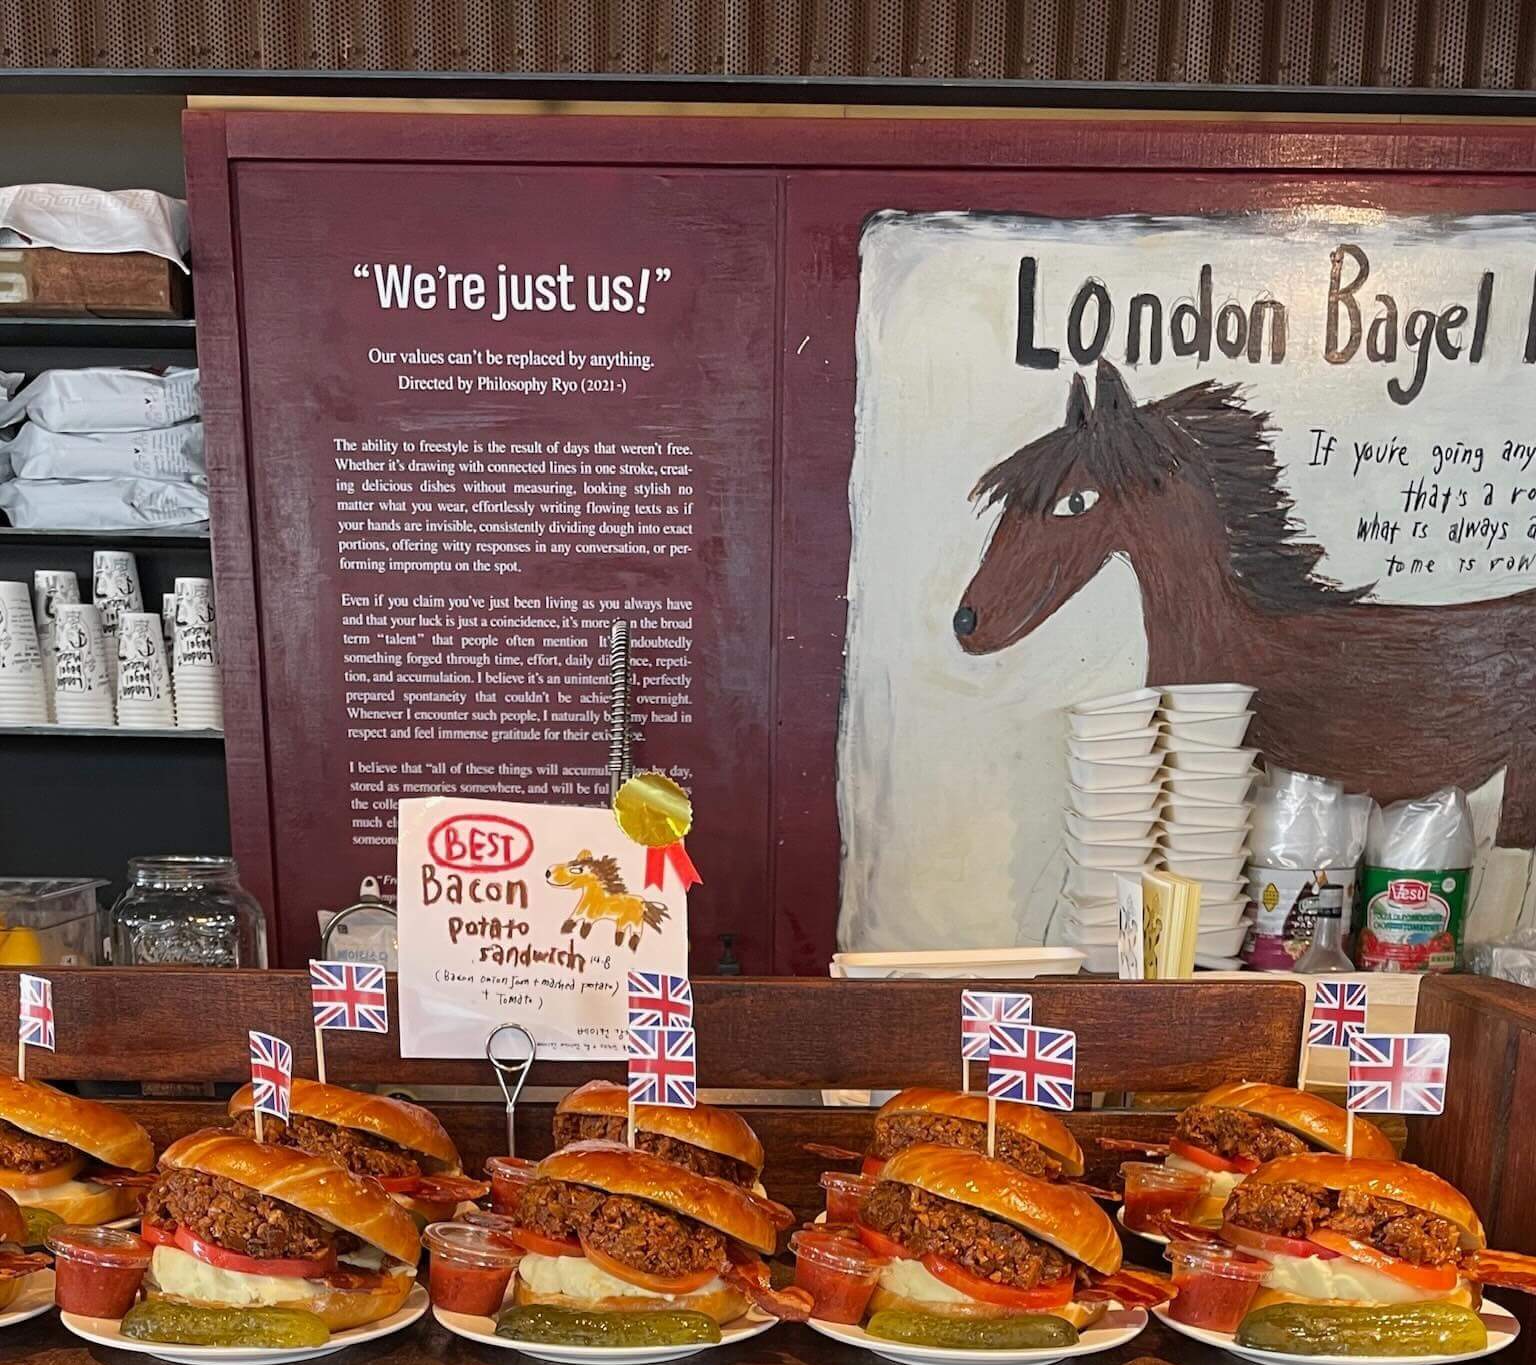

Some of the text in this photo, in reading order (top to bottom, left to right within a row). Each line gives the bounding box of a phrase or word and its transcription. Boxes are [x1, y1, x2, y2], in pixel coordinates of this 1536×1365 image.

[492, 263, 576, 321] just
[588, 267, 671, 315] us!”
[1016, 244, 1494, 405] London Bagel
[369, 348, 396, 363] Our
[400, 348, 444, 365] values
[486, 349, 503, 365] be
[507, 349, 565, 370] replaced
[569, 350, 586, 370] by
[399, 376, 453, 390] Directed
[458, 376, 473, 394] by
[478, 376, 547, 395] Philosophy
[552, 377, 577, 395] Ryo
[334, 438, 357, 451] The
[362, 439, 398, 455] ability
[403, 441, 415, 452] to
[420, 439, 468, 456] freestyle
[474, 440, 483, 453] is
[488, 441, 506, 453] the
[511, 441, 542, 453] result
[547, 441, 560, 453] of
[563, 441, 589, 457] days
[594, 442, 615, 454] that
[1308, 429, 1338, 467] If
[1432, 442, 1484, 475] going
[335, 458, 385, 471] Whether
[408, 460, 455, 475] drawing
[459, 460, 484, 472] with
[488, 460, 545, 473] connected
[550, 461, 576, 474] lines
[581, 462, 591, 474] in
[595, 465, 616, 475] one
[337, 479, 354, 495] ing
[362, 479, 412, 492] delicious
[420, 479, 456, 492] dishes
[464, 480, 506, 494] without
[584, 482, 626, 496] looking
[634, 482, 671, 496] stylish
[679, 485, 693, 495] no
[1484, 483, 1494, 506] a
[337, 500, 374, 511] matter
[379, 499, 406, 511] what
[412, 503, 432, 515] you
[472, 500, 534, 515] effortlessly
[540, 501, 581, 516] writing
[587, 501, 630, 516] flowing
[635, 504, 661, 514] texts
[667, 505, 678, 514] as
[684, 502, 693, 514] if
[338, 521, 364, 534] your
[368, 518, 401, 531] hands
[404, 522, 422, 531] are
[479, 521, 545, 535] consistently
[549, 521, 595, 535] dividing
[599, 521, 634, 536] dough
[638, 522, 660, 534] into
[663, 524, 692, 535] exact
[1412, 521, 1428, 539] is
[1448, 517, 1509, 549] always
[392, 538, 438, 554] offering
[443, 539, 471, 554] witty
[476, 542, 531, 555] responses
[536, 540, 546, 553] in
[551, 544, 571, 555] any
[653, 545, 666, 554] or
[340, 557, 385, 573] forming
[389, 558, 451, 575] impromptu
[455, 563, 469, 572] on
[473, 560, 490, 572] the
[1410, 559, 1435, 574] me
[1459, 558, 1475, 573] is
[1490, 555, 1536, 573] row
[342, 593, 369, 606] Even
[375, 593, 384, 606] if
[388, 598, 408, 610] you
[413, 595, 444, 608] claim
[489, 595, 509, 611] just
[514, 596, 540, 608] been
[546, 595, 578, 612] living
[583, 600, 595, 610] as
[600, 600, 619, 612] you
[625, 597, 662, 612] always
[667, 597, 692, 610] have
[631, 710, 692, 725] my head in
[348, 727, 593, 743] respect and feel immense gratitude for their
[350, 780, 384, 792] stored
[387, 783, 399, 792] as
[403, 781, 457, 792] memories
[528, 782, 548, 794] and
[552, 782, 573, 794] will
[577, 782, 590, 794] be
[445, 827, 515, 864] BEST
[422, 863, 529, 909] Bacon
[448, 916, 530, 943] potato
[479, 939, 586, 973] sandwich
[480, 974, 508, 985] onion
